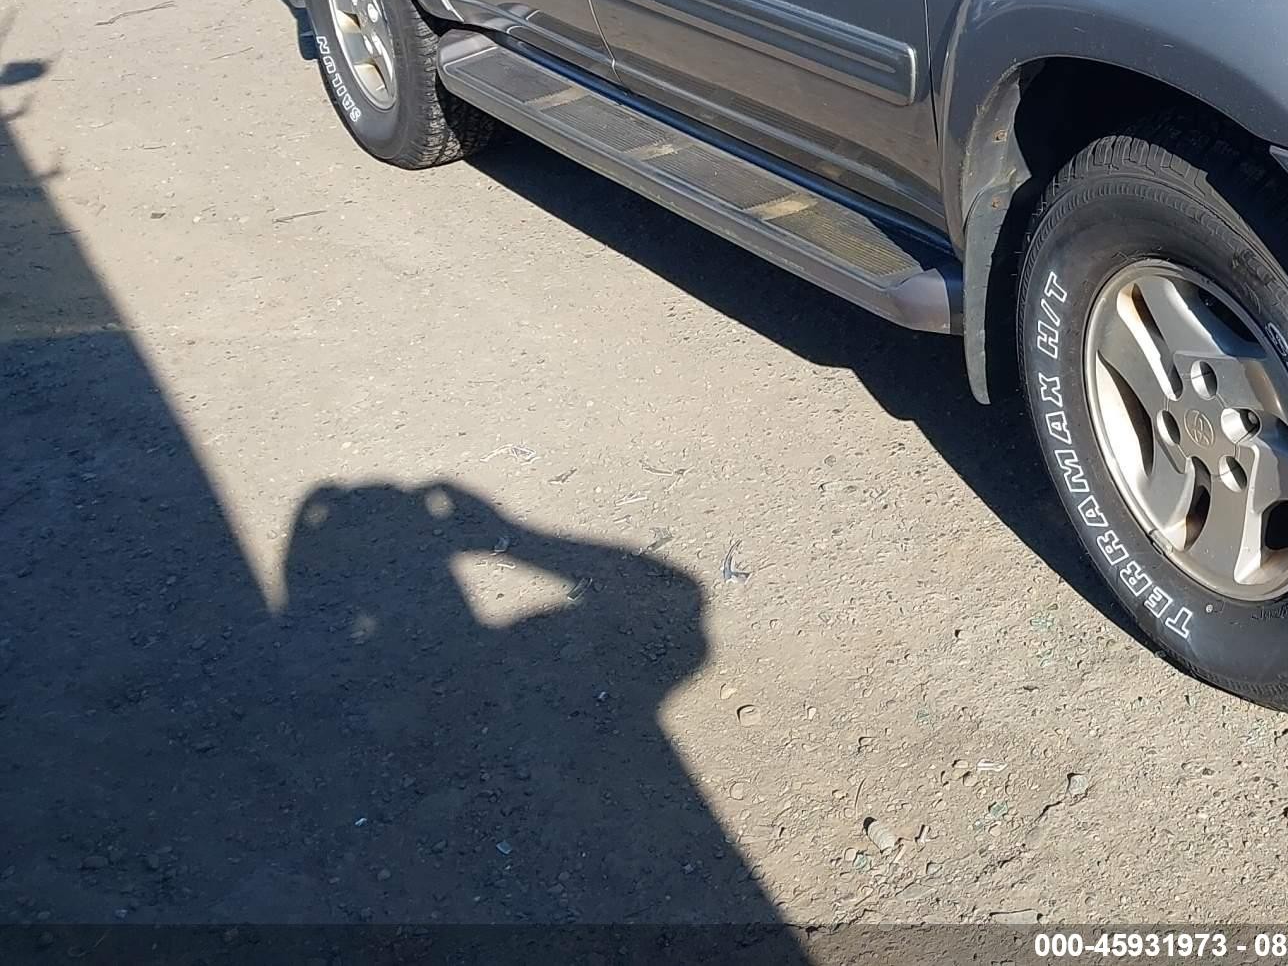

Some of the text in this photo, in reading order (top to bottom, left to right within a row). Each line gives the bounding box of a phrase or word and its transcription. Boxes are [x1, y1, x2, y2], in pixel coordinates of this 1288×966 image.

[316, 36, 362, 123] SAILUN
[1037, 270, 1195, 639] TERRAMAX H/T
